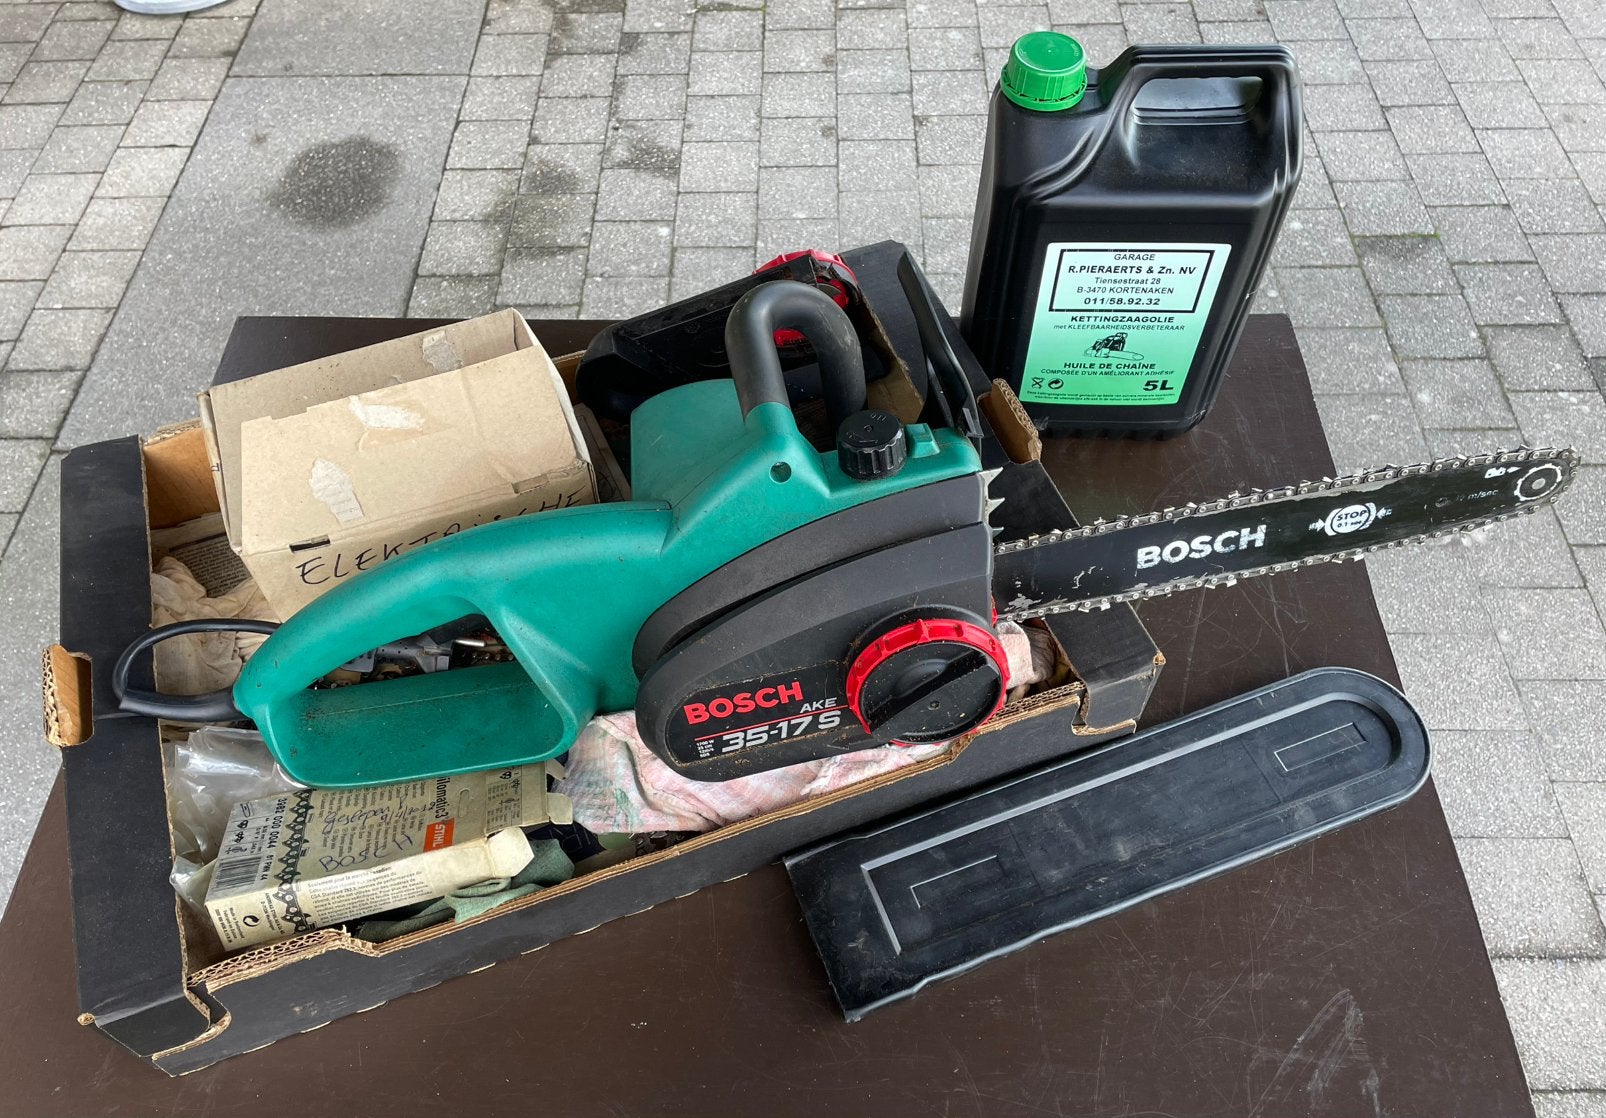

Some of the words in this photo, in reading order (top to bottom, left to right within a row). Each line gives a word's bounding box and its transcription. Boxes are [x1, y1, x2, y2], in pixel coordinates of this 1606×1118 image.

[1068, 266, 1142, 274] R.PIERAERTS
[1146, 266, 1154, 274] &
[1179, 266, 1196, 275] NV
[1143, 380, 1174, 391] 5L
[1337, 510, 1367, 521] STOP
[1137, 525, 1267, 569] BOSCH
[683, 681, 804, 725] BOSCH
[800, 697, 838, 714] AKE
[722, 715, 813, 753] 35-17
[818, 710, 841, 730] S
[435, 776, 450, 819] ilomatic3
[433, 824, 445, 848] STIHL
